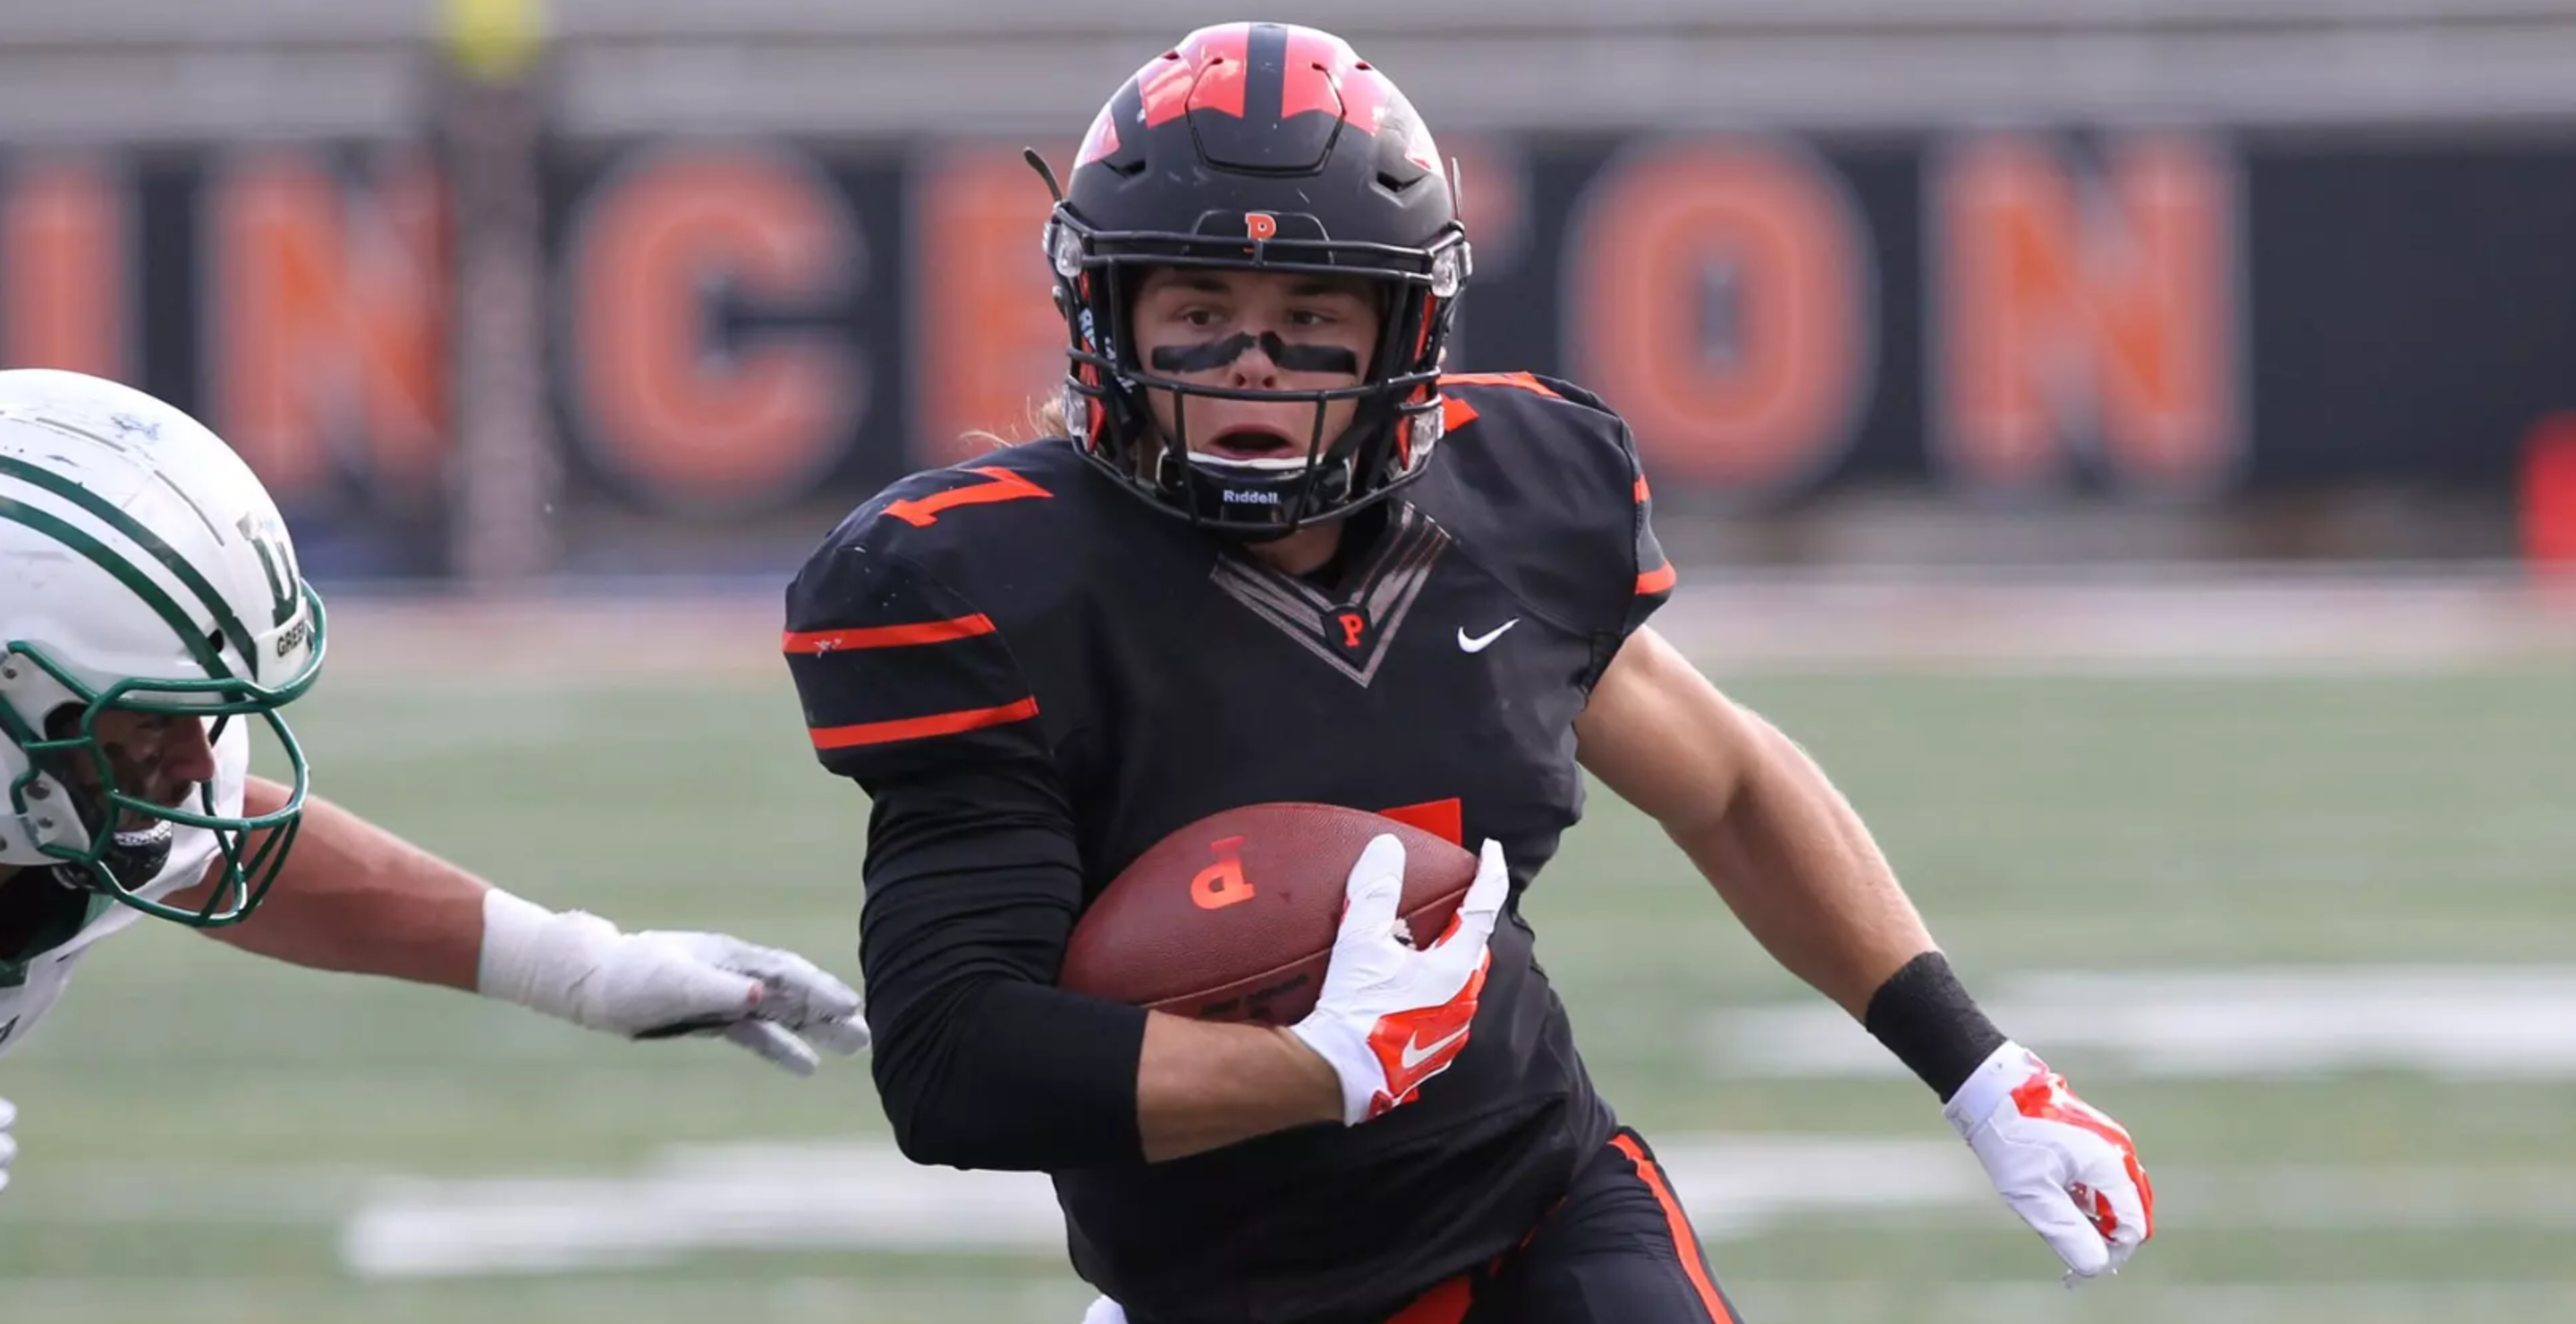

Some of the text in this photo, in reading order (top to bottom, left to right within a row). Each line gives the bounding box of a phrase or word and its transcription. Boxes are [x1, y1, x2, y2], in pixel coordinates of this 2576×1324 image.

[1244, 212, 1277, 253] P
[1224, 489, 1278, 504] Riddell
[1338, 614, 1363, 648] P
